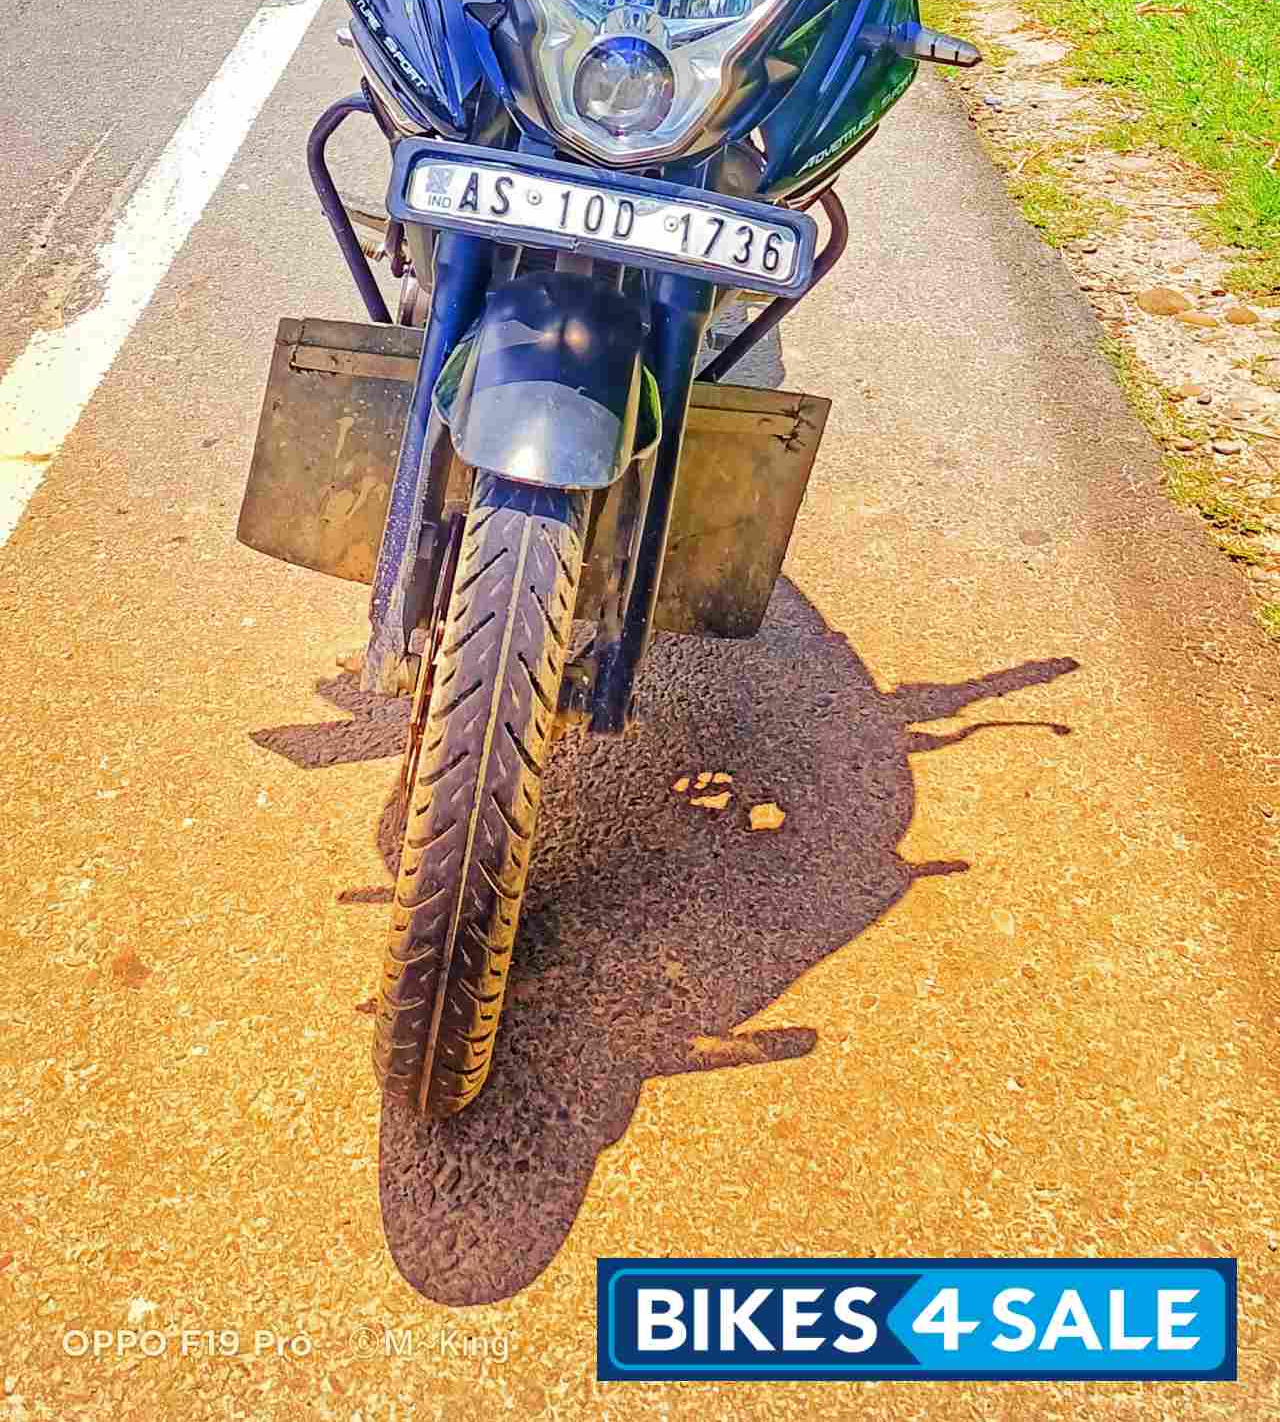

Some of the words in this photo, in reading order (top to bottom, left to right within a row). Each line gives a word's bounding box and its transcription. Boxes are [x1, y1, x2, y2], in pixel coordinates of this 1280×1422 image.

[384, 35, 428, 88] SPORT
[427, 194, 452, 209] IND
[459, 172, 515, 215] AS
[558, 189, 634, 238] 10D
[678, 212, 782, 272] 1736
